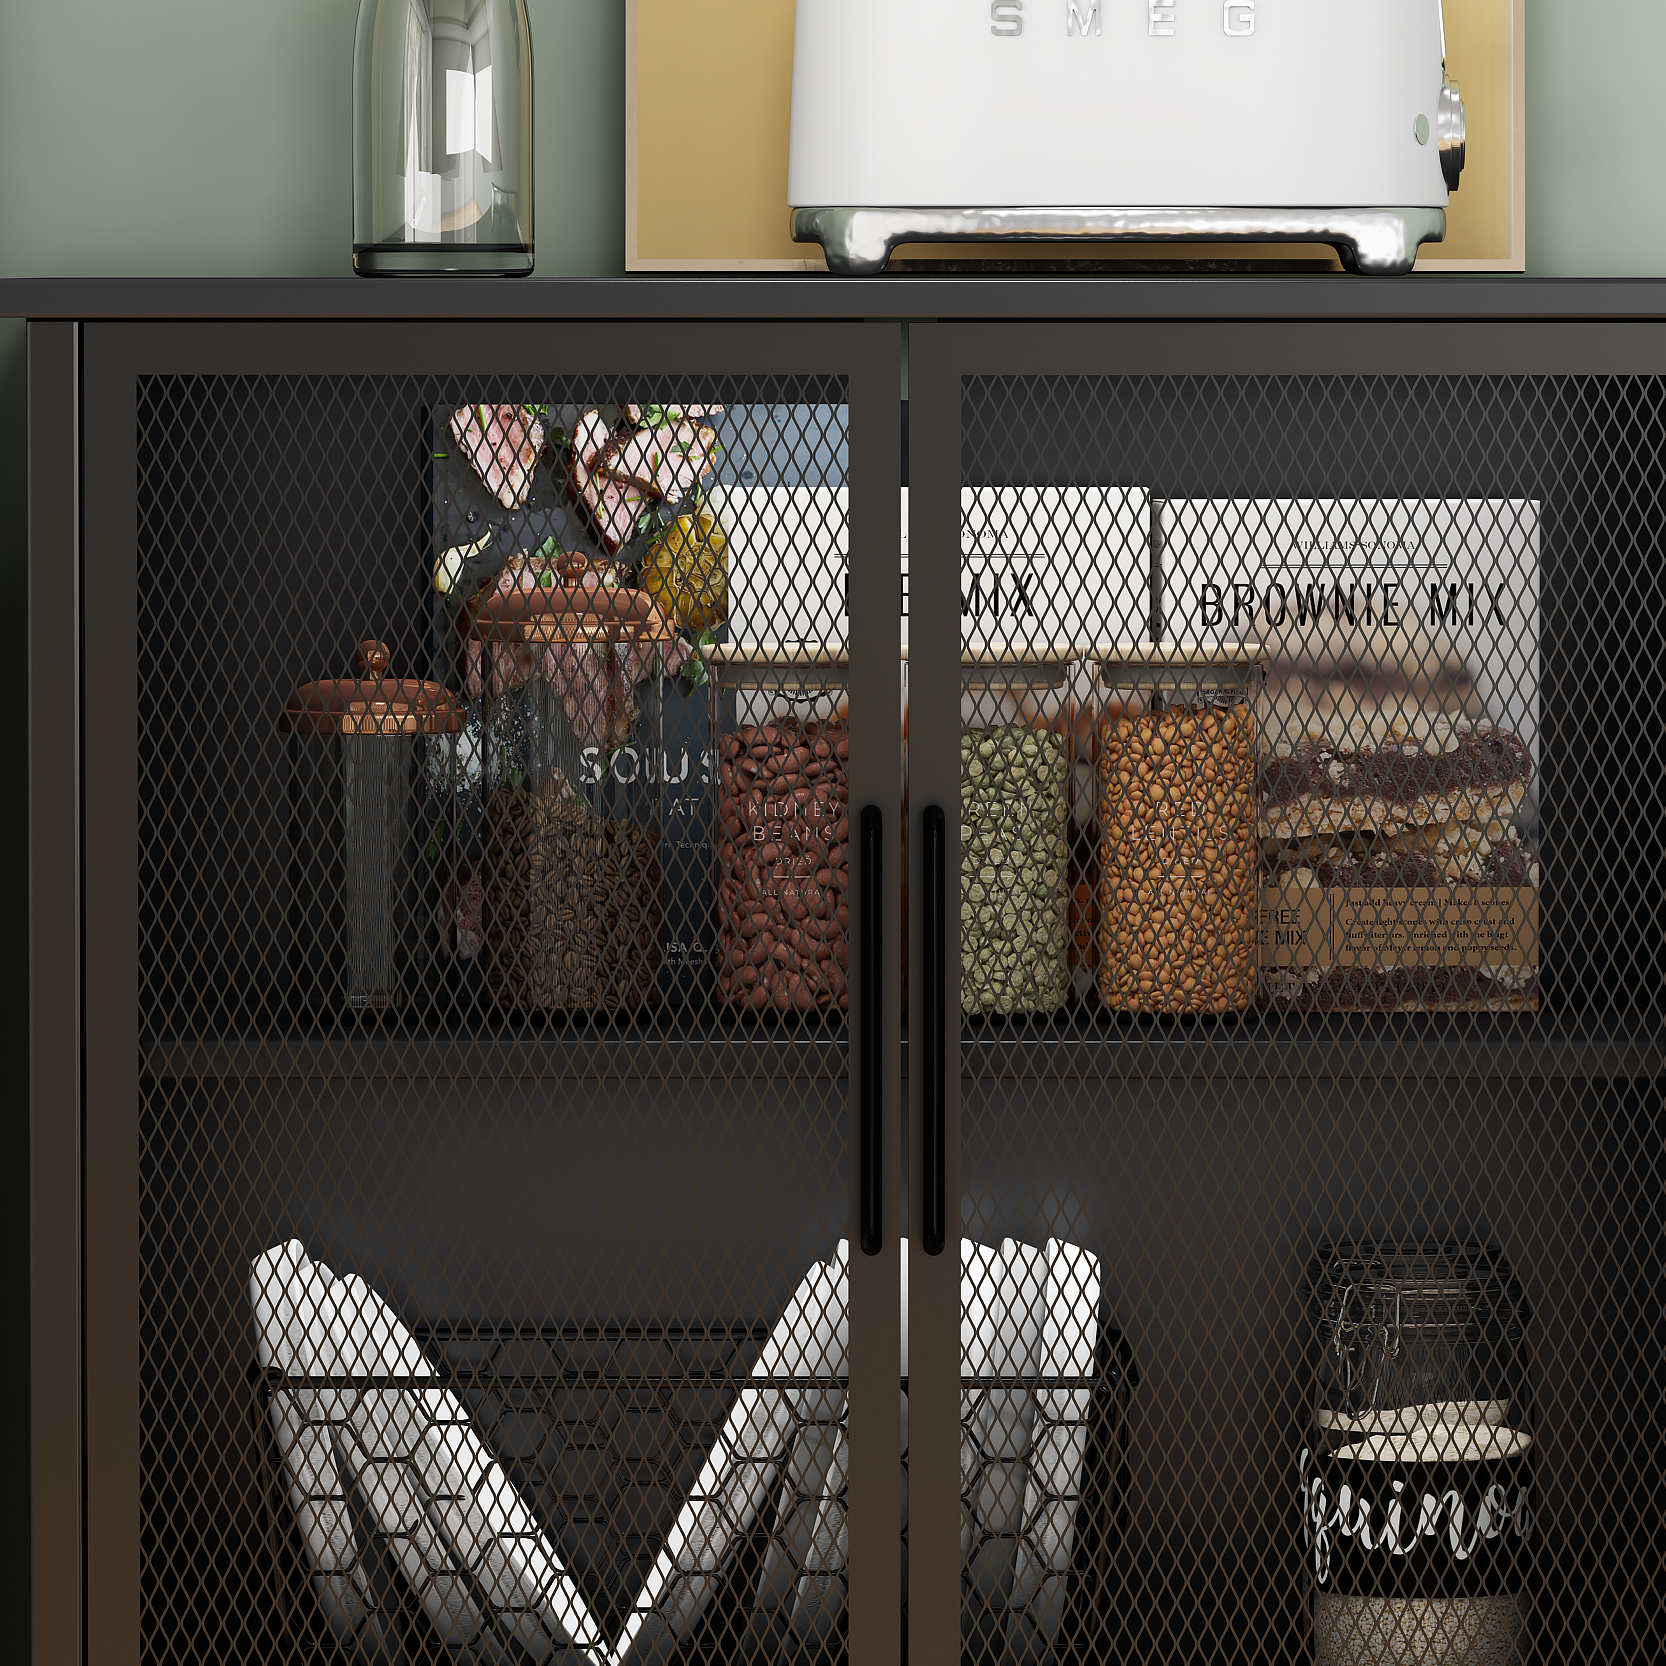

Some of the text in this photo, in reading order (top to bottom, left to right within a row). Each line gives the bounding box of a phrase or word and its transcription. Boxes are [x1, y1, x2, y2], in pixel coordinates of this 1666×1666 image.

[960, 573, 1034, 617] MIX
[1200, 582, 1506, 627] BROWNIE MIX
[748, 801, 839, 817] KIDNEY
[968, 801, 1032, 817] REEN
[1156, 801, 1206, 817] RED
[753, 825, 834, 841] BEANS
[775, 857, 812, 865] DRIED
[972, 857, 1010, 865] DRED
[1275, 930, 1306, 945] MIX
[1408, 930, 1447, 938] nriched
[1383, 944, 1411, 953] Meyr
